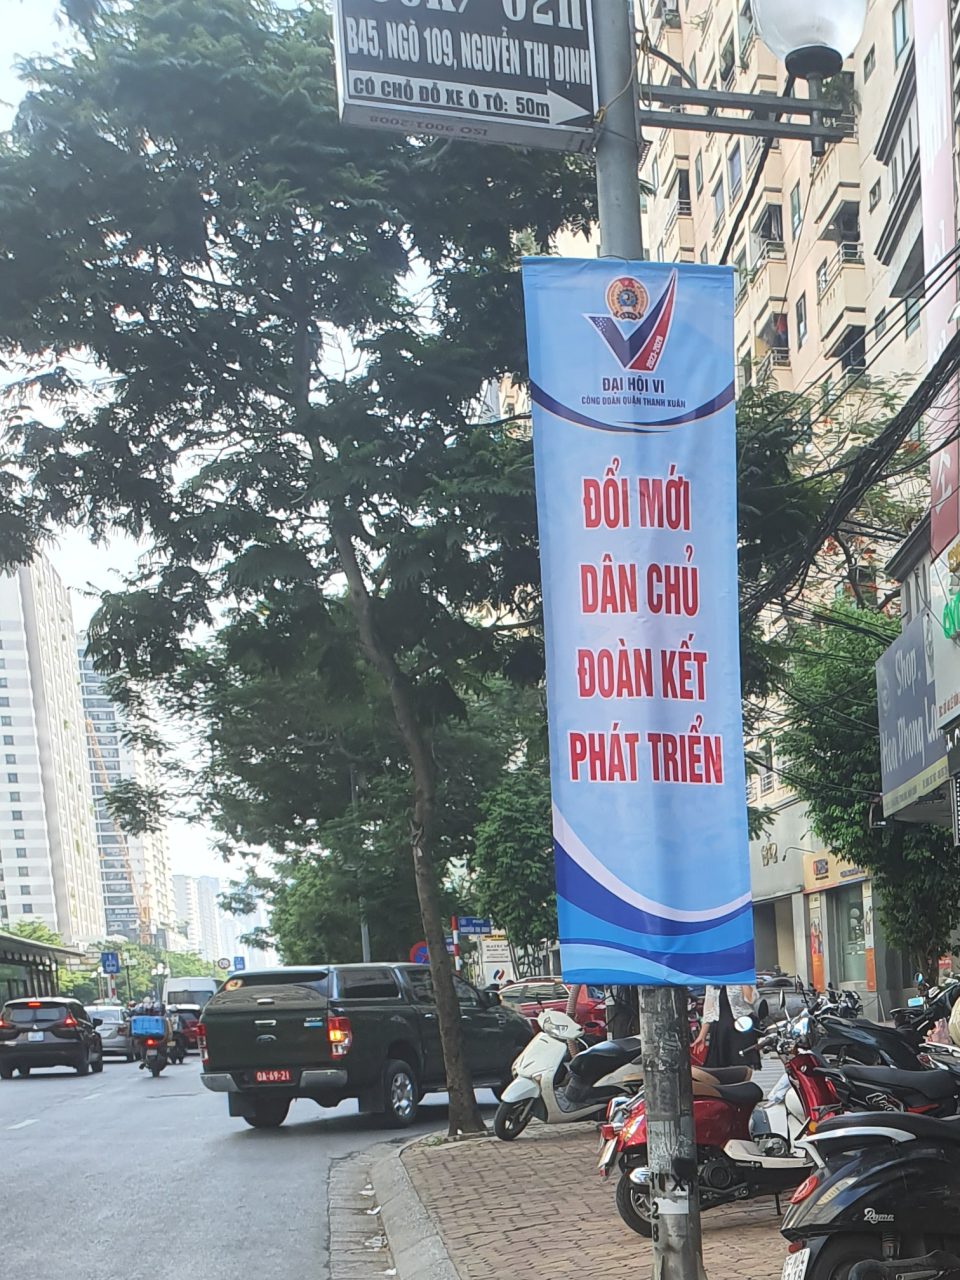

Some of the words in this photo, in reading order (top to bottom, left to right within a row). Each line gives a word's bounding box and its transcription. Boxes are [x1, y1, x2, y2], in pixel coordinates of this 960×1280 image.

[346, 17, 384, 61] B45,
[423, 27, 458, 71] 109,
[524, 40, 550, 87] THỊ
[554, 44, 592, 90] ĐỊNH
[353, 76, 376, 96] CÓ
[381, 78, 414, 102] CHỖ
[419, 81, 441, 104] ĐỖ
[445, 88, 463, 106] XE
[468, 89, 480, 108] Ô
[516, 95, 550, 118] 50m
[602, 377, 624, 395] ĐẠI
[628, 375, 649, 395] HỘI
[652, 379, 665, 394] VI
[643, 397, 667, 408] THANH
[583, 457, 630, 530] ĐỔI
[638, 464, 691, 532] MỚI
[580, 553, 638, 615] DÂN
[646, 544, 699, 617] CHỦ
[577, 638, 655, 699] ĐOÀN
[660, 633, 709, 702] KẾT
[568, 721, 640, 783] PHÁT
[646, 714, 724, 785] TRIỂN
